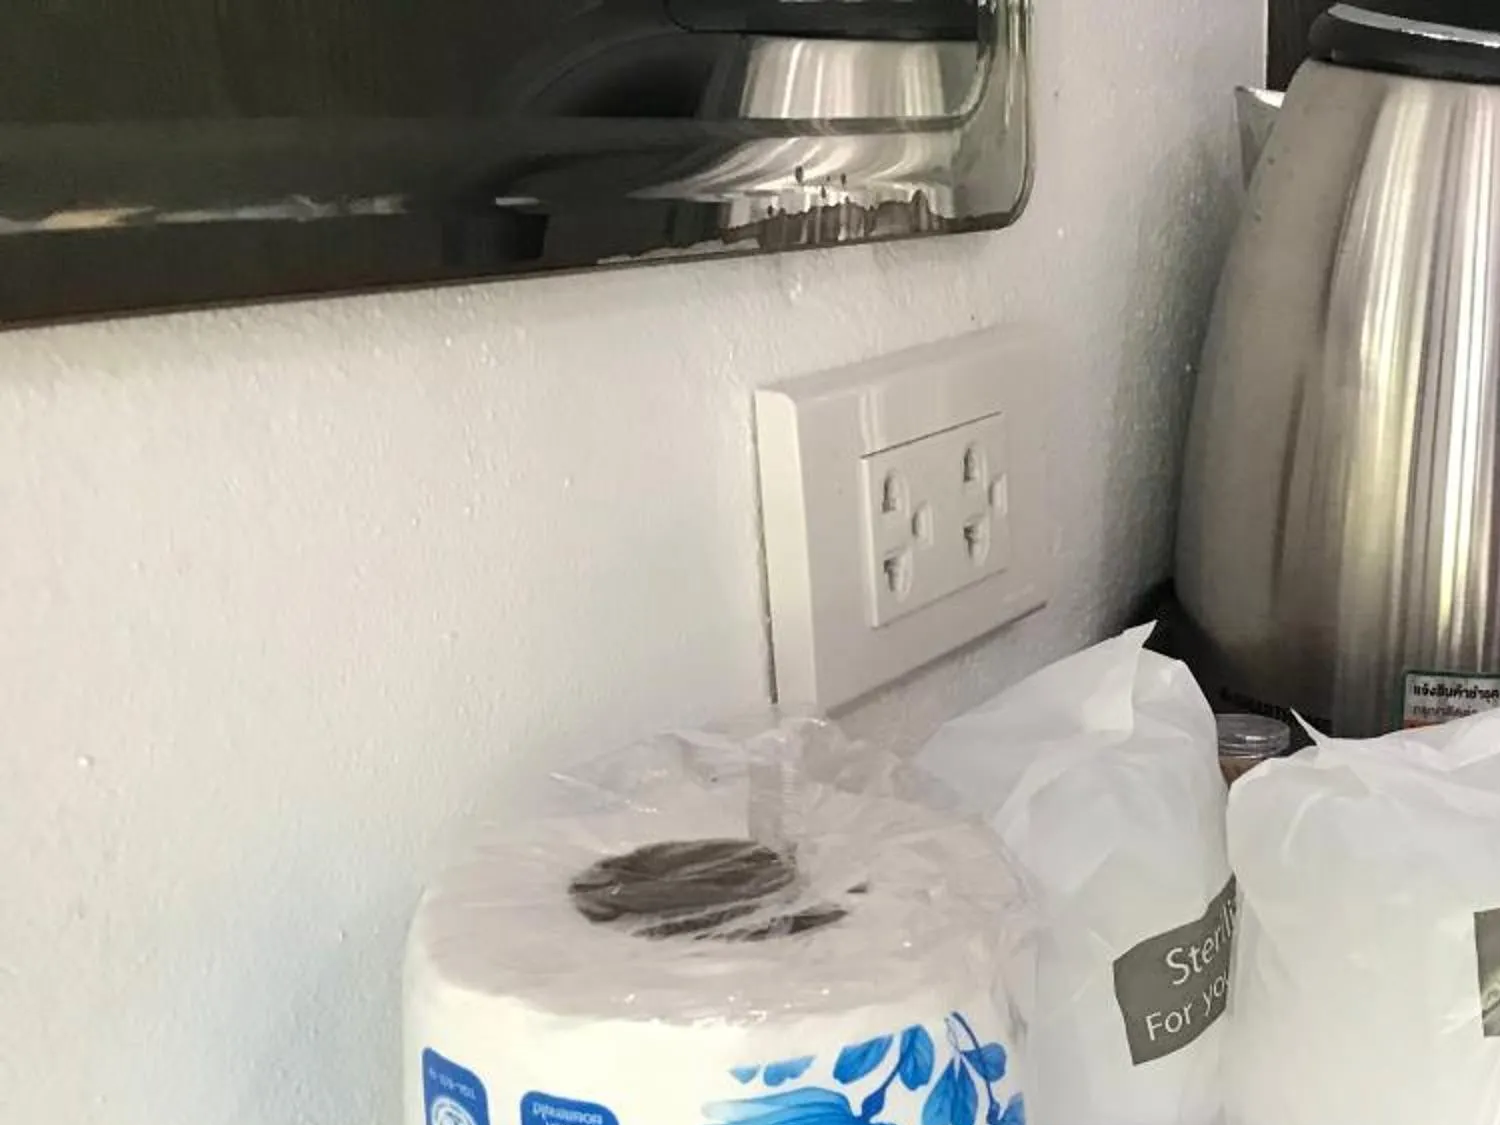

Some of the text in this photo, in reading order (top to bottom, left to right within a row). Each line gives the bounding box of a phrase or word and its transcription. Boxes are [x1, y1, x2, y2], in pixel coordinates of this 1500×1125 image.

[1165, 899, 1235, 985] Sterili
[1145, 971, 1230, 1041] For yo
